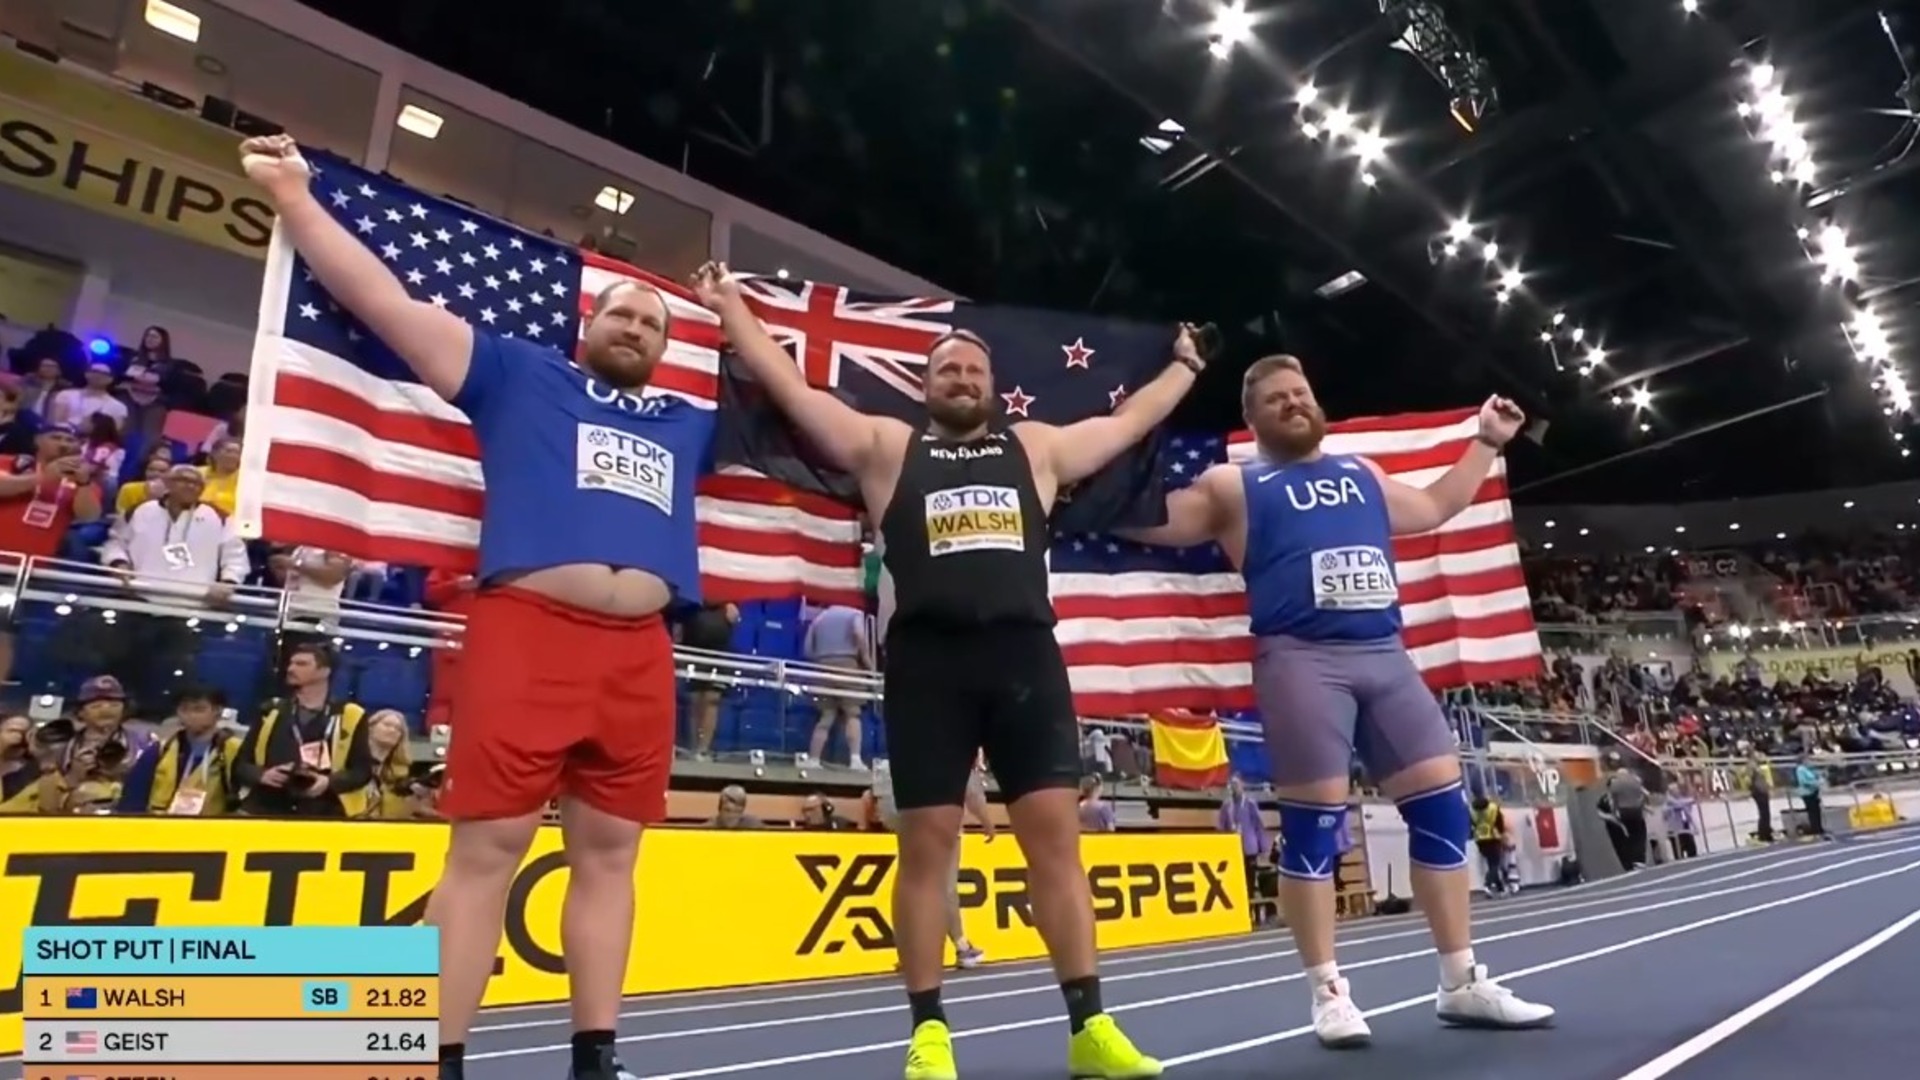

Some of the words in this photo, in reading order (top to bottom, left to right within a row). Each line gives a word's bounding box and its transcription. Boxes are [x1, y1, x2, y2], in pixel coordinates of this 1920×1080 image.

[0, 120, 276, 247] SHIPS
[610, 431, 667, 469] TDK
[593, 451, 665, 488] GEIST
[952, 489, 1012, 508] TDK
[1285, 476, 1365, 510] USA
[932, 512, 1018, 534] WALSH
[1337, 550, 1385, 568] TDK
[1322, 572, 1391, 592] STEEN
[957, 860, 1234, 929] PRSPEX
